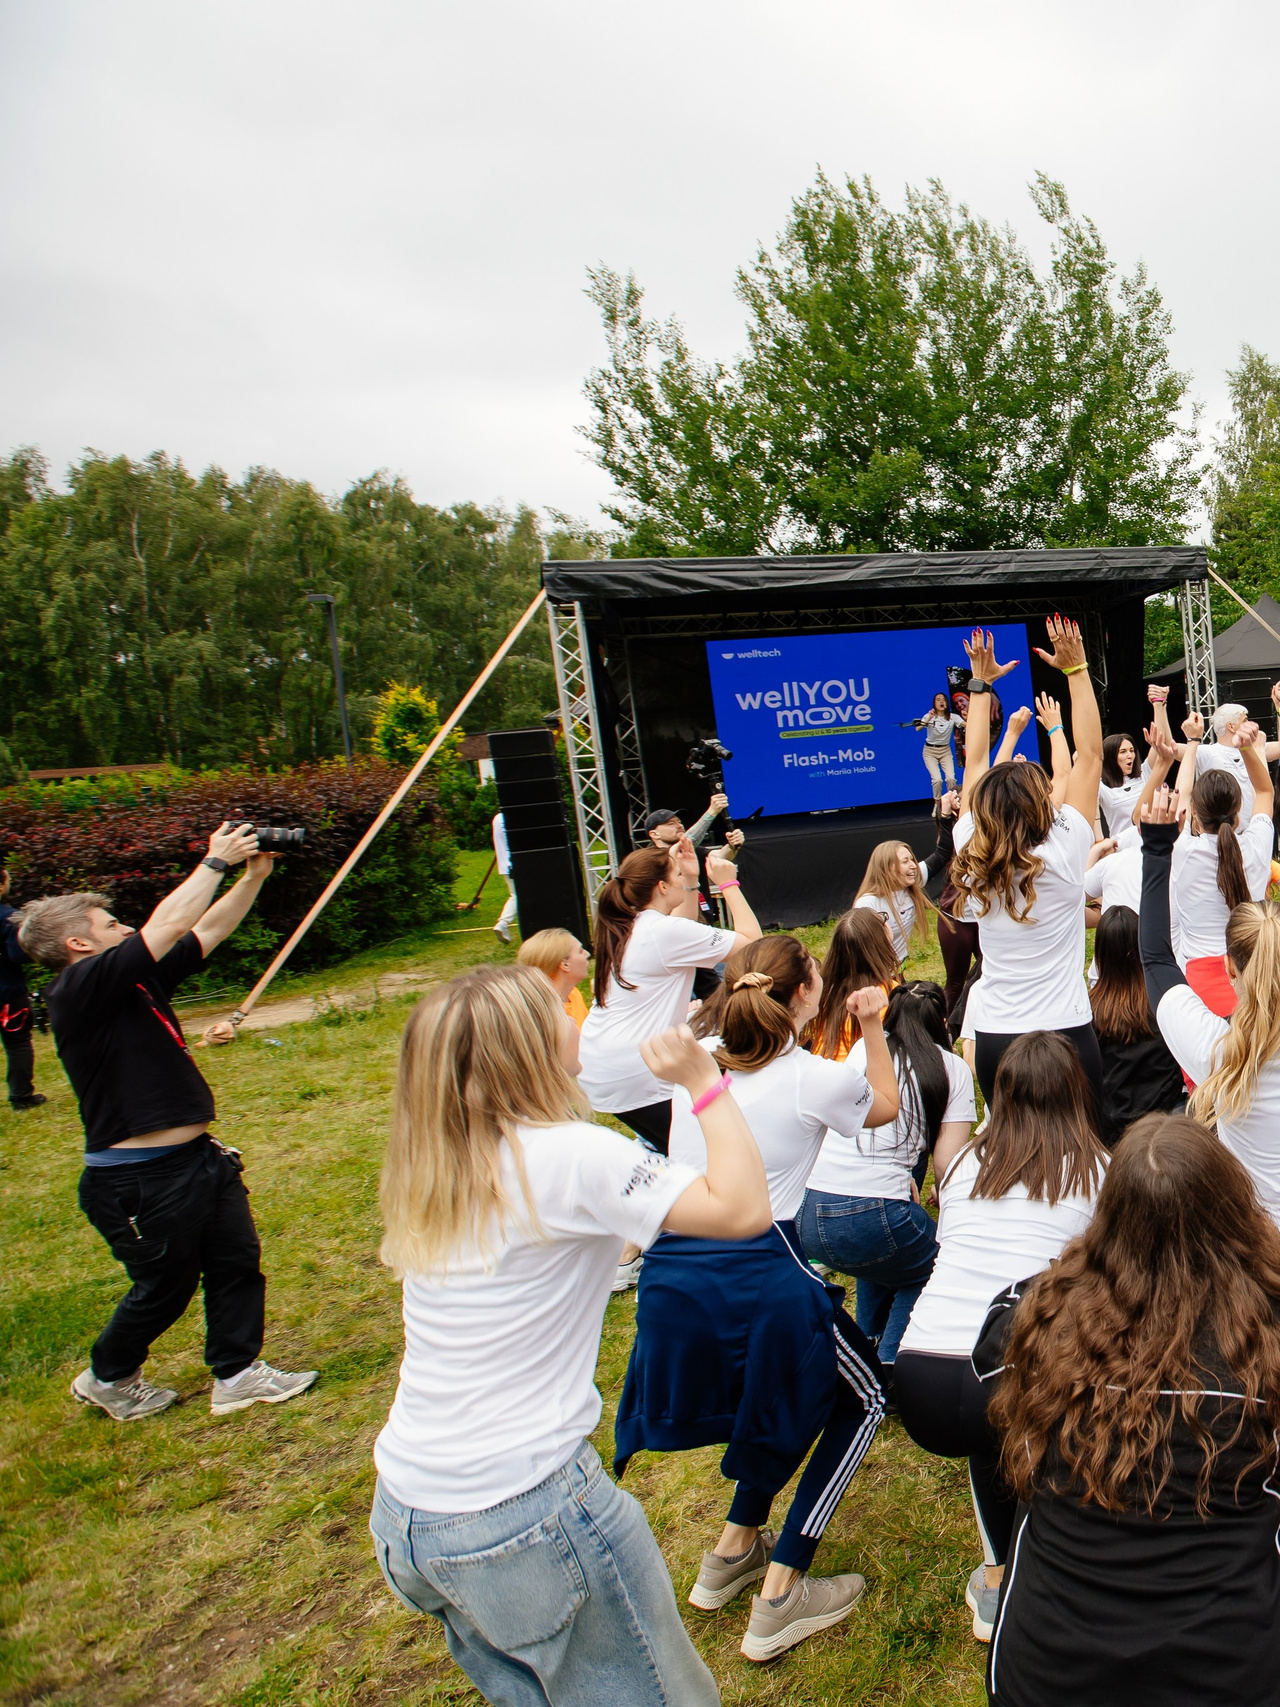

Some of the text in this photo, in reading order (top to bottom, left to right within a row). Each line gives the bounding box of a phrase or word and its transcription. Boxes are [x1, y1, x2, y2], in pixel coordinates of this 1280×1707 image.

[737, 648, 781, 659] welltech
[735, 677, 870, 710] wellYOU
[776, 703, 872, 728] move
[783, 747, 875, 768] Flash-Mob
[808, 765, 877, 778] with Mariia Holub
